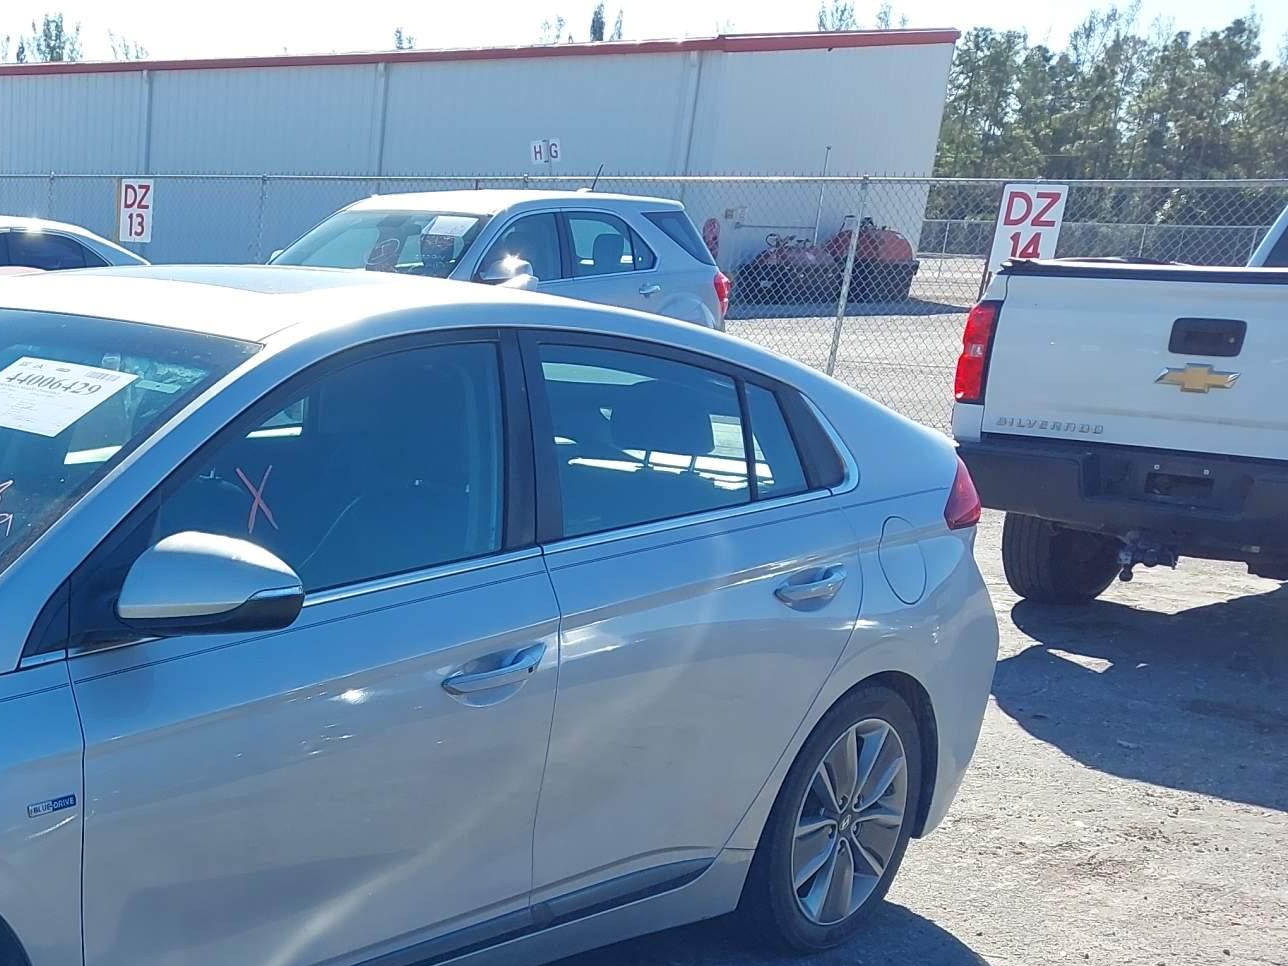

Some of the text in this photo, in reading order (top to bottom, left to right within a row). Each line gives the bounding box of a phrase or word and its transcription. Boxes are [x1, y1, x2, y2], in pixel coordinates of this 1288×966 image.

[533, 142, 559, 160] H G
[123, 184, 151, 209] DZ
[1003, 191, 1062, 228] DZ
[128, 213, 145, 237] 13
[1009, 231, 1042, 260] 14
[6, 372, 103, 396] 44006429
[996, 417, 1104, 435] SILVERADO
